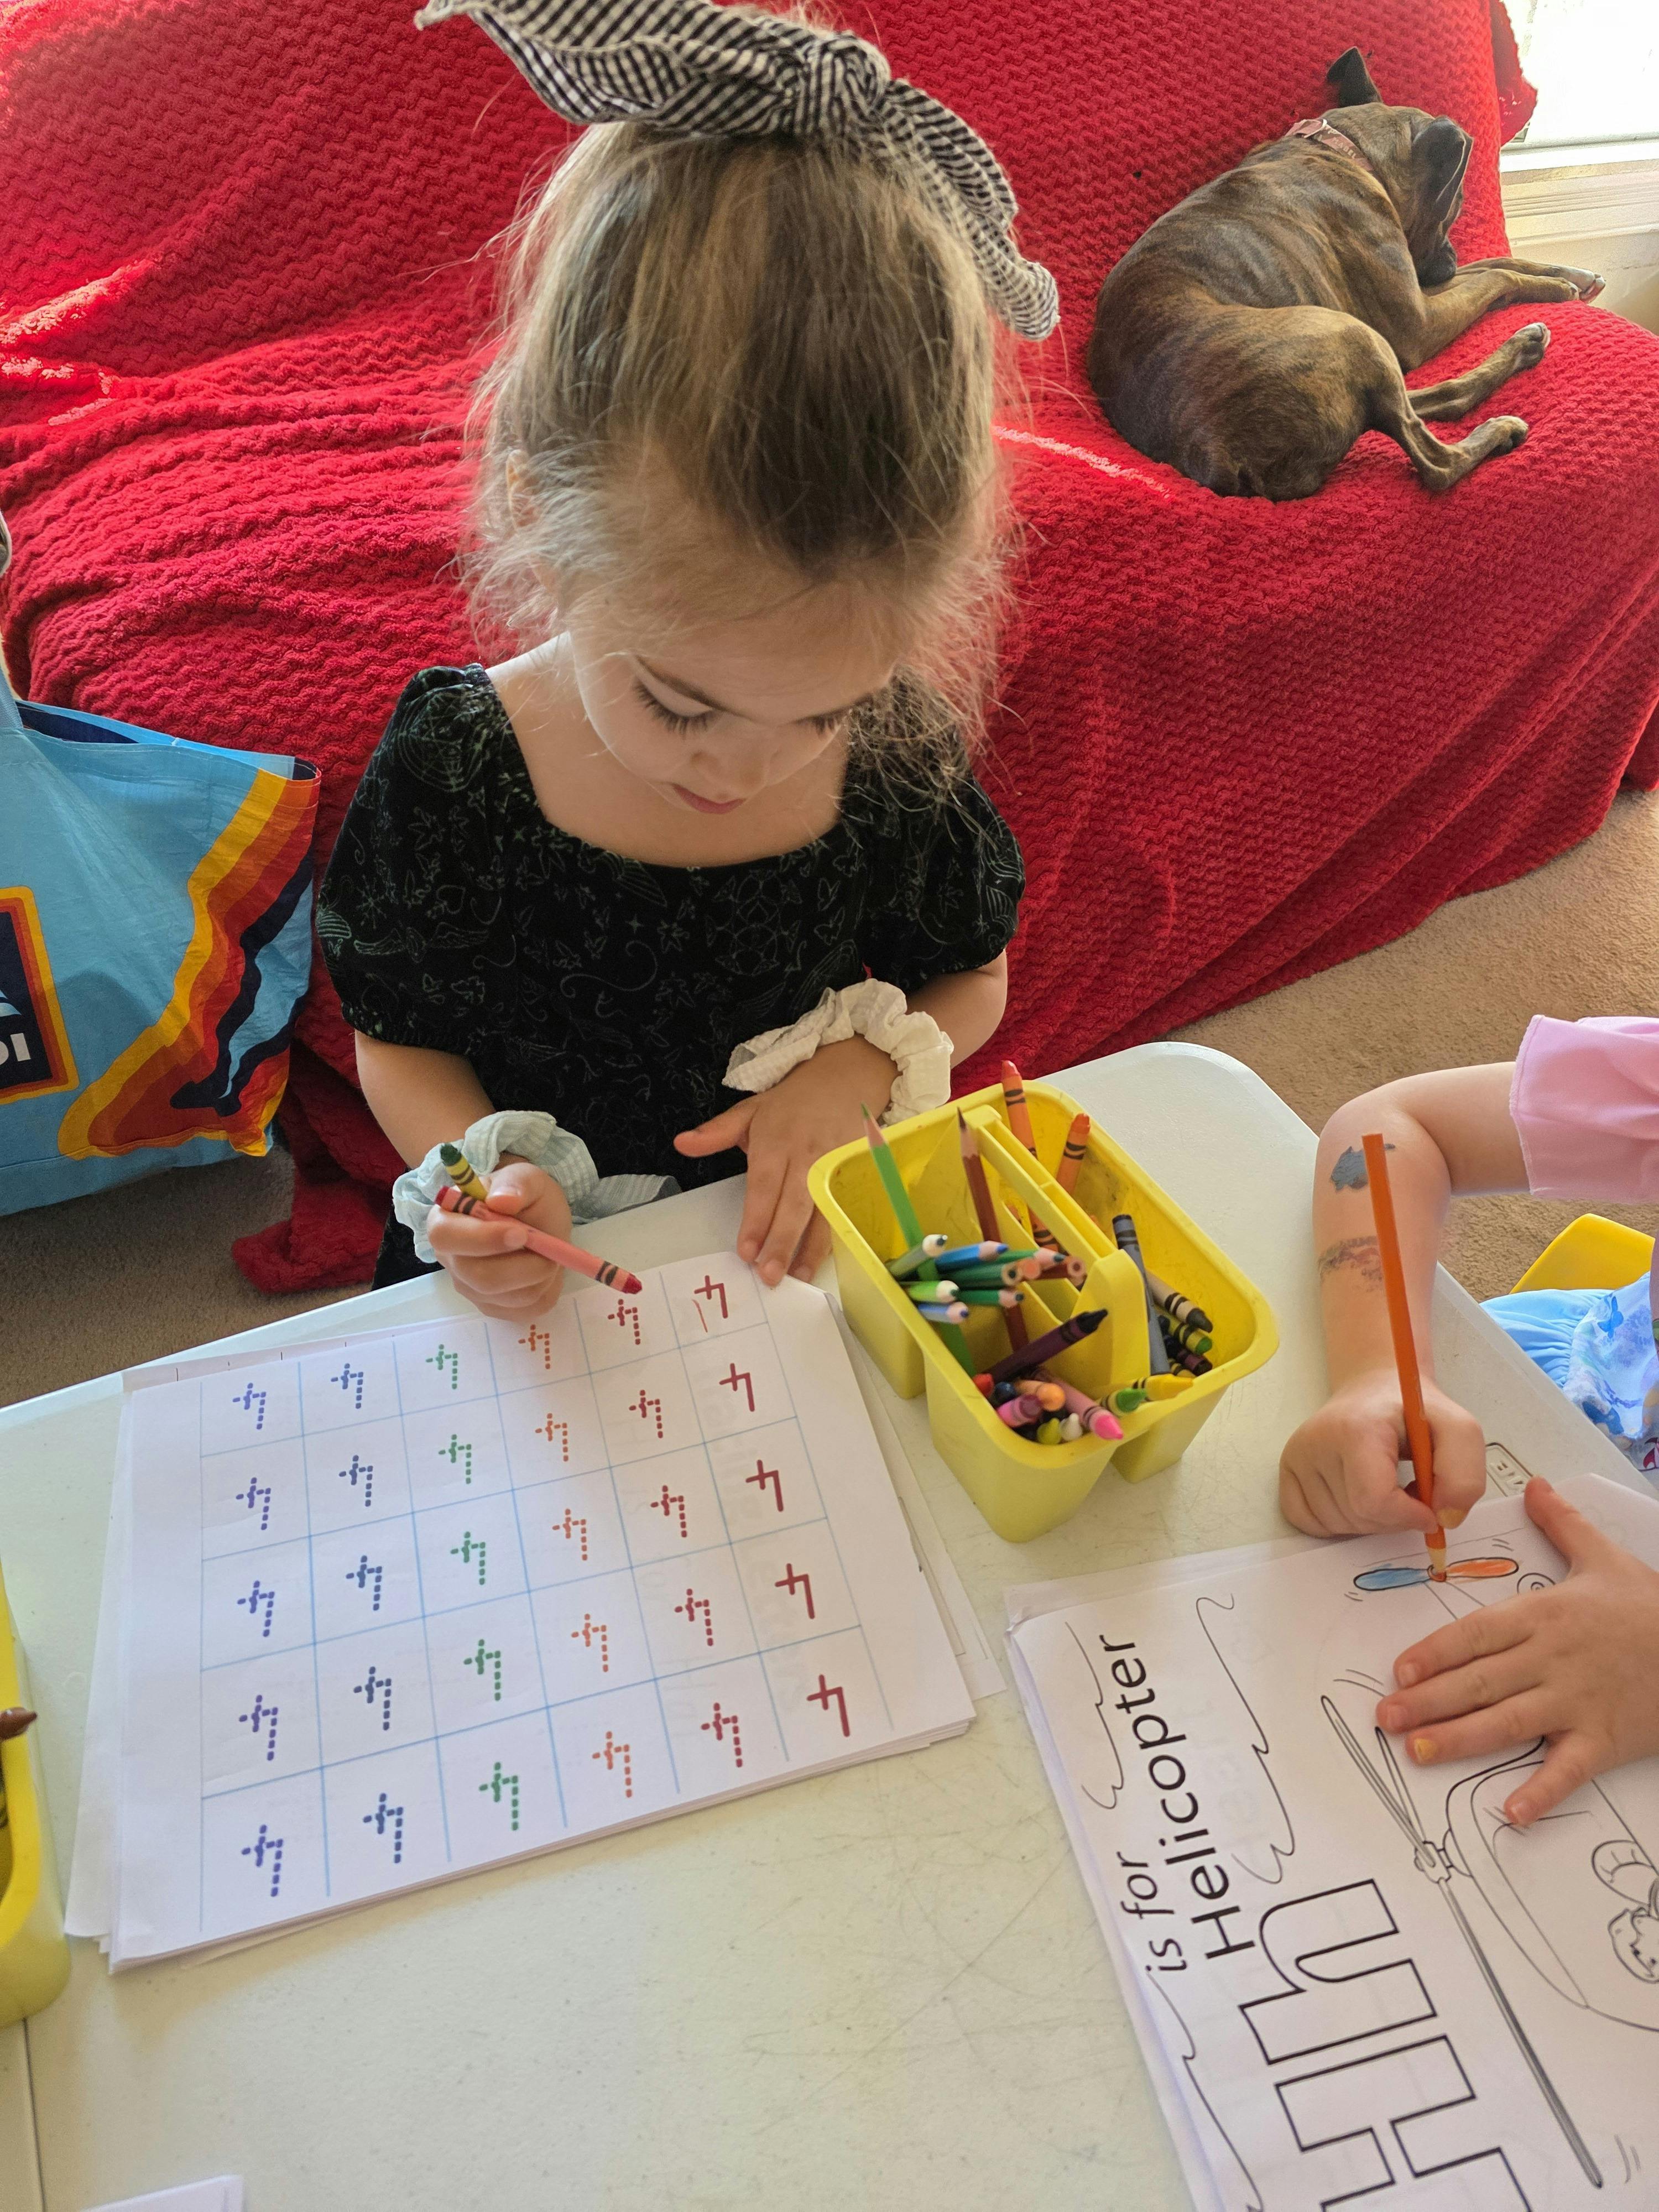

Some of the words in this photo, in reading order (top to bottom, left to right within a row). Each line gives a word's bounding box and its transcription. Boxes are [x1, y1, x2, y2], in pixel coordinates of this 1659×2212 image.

[1332, 137, 1357, 159] MABEL
[608, 1299, 641, 1344] 4
[695, 1276, 728, 1318] 4
[427, 1345, 457, 1389] 4
[519, 1325, 550, 1369] 4
[233, 1384, 266, 1430] 4
[331, 1364, 363, 1408] 4
[720, 1363, 755, 1412] 4
[536, 1413, 568, 1461] 4
[629, 1390, 663, 1438] 4
[340, 1455, 373, 1506] 4
[439, 1434, 471, 1484] 4
[237, 1478, 271, 1530] 4
[651, 1485, 687, 1537] 4
[746, 1460, 784, 1512] 4
[451, 1532, 486, 1585] 4
[553, 1509, 587, 1561] 4
[237, 1581, 274, 1637] 4
[346, 1556, 382, 1610] 4
[775, 1563, 815, 1619] 4
[572, 1614, 608, 1672] 4
[675, 1589, 713, 1646] 4
[465, 1640, 500, 1700] 4
[354, 1667, 391, 1730] 4
[807, 1675, 850, 1736] 4
[239, 1695, 278, 1761] 4
[701, 1703, 742, 1767] 4
[593, 1731, 632, 1797] 4
[479, 1762, 518, 1830] 4
[1099, 1634, 1255, 1960] Helicopter
[363, 1793, 403, 1863] 4
[242, 1825, 283, 1897] 4
[1115, 1851, 1175, 1919] for
[1145, 1938, 1187, 1971] is
